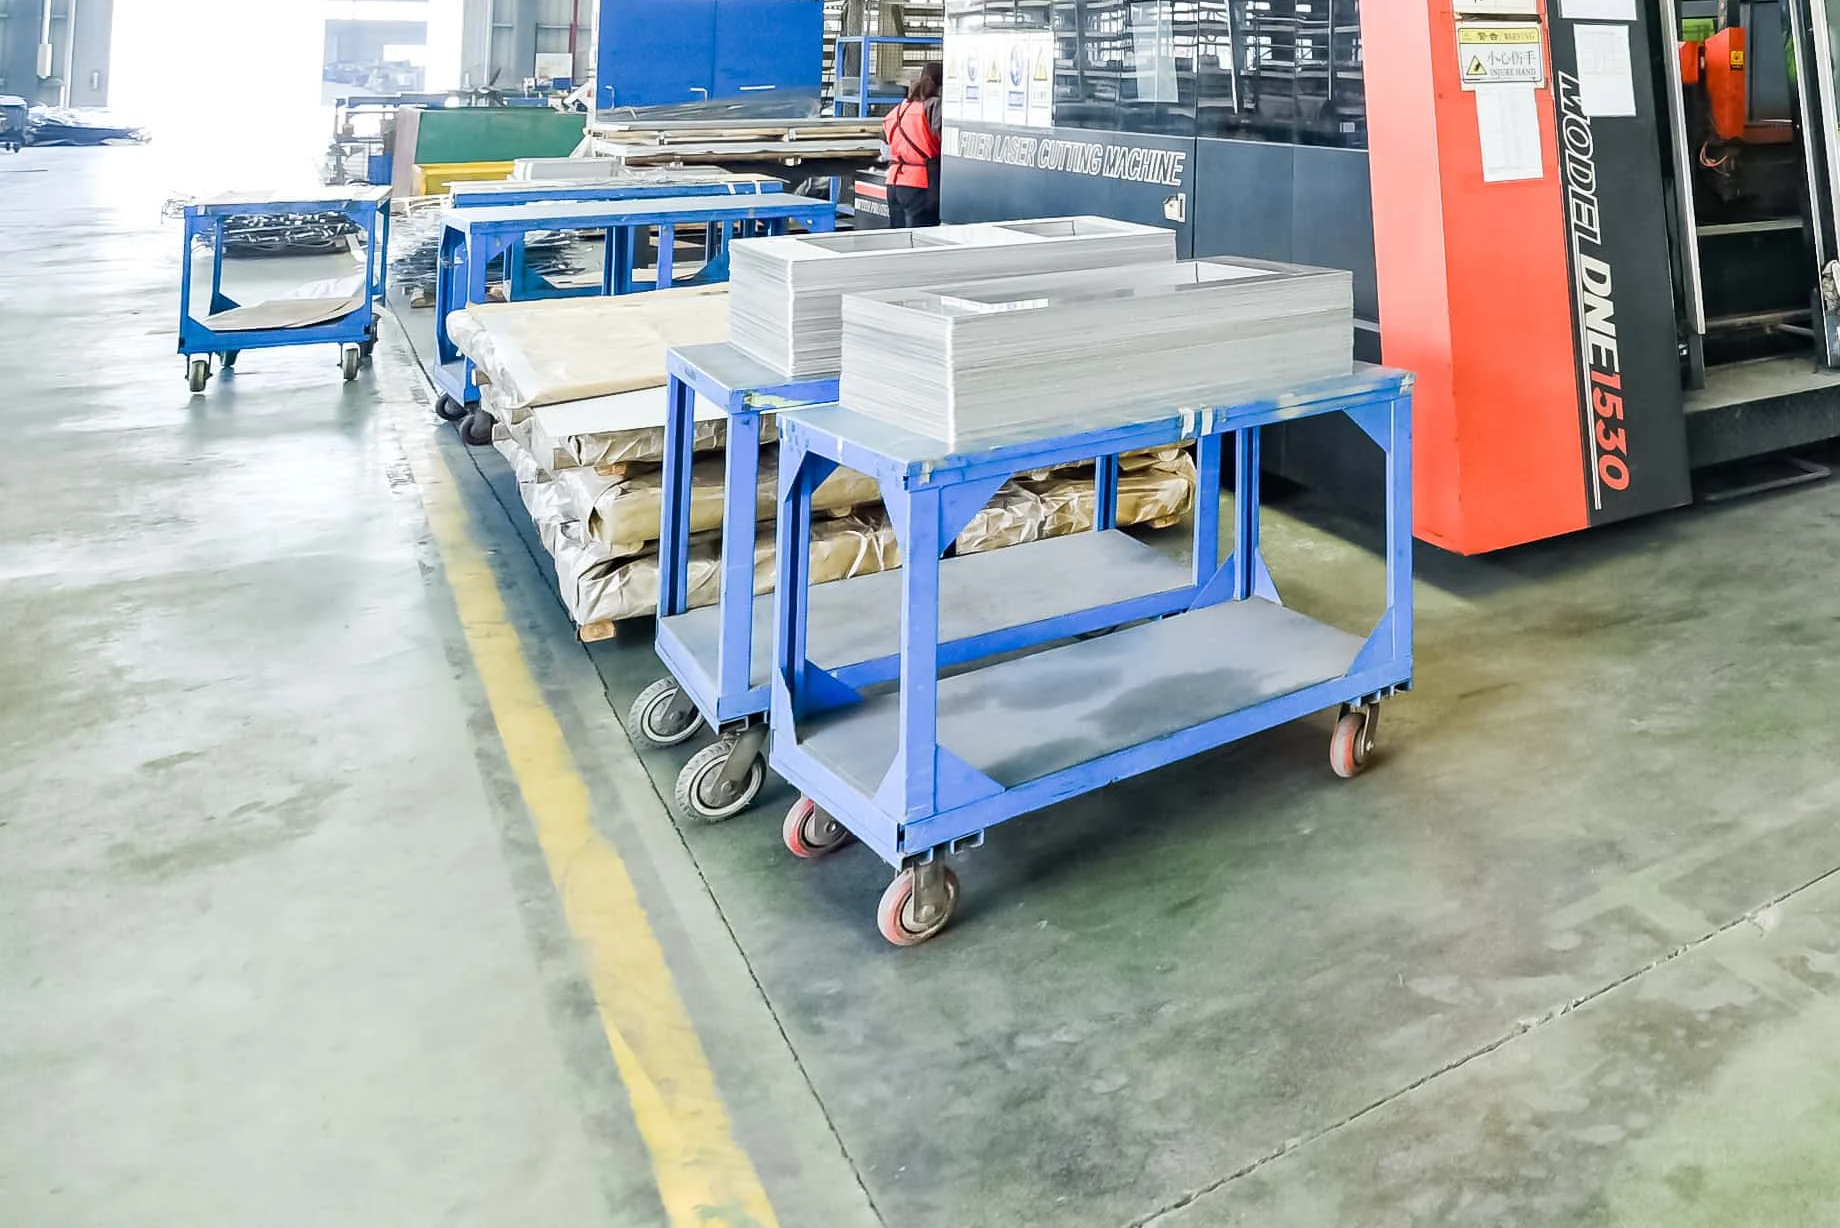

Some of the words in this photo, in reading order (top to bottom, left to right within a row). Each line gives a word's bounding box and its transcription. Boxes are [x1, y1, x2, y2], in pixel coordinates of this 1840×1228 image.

[993, 134, 1038, 167] LASER
[1037, 138, 1104, 176] CUTTING
[1102, 144, 1187, 187] MACHINE
[1558, 70, 1602, 245] MODEL
